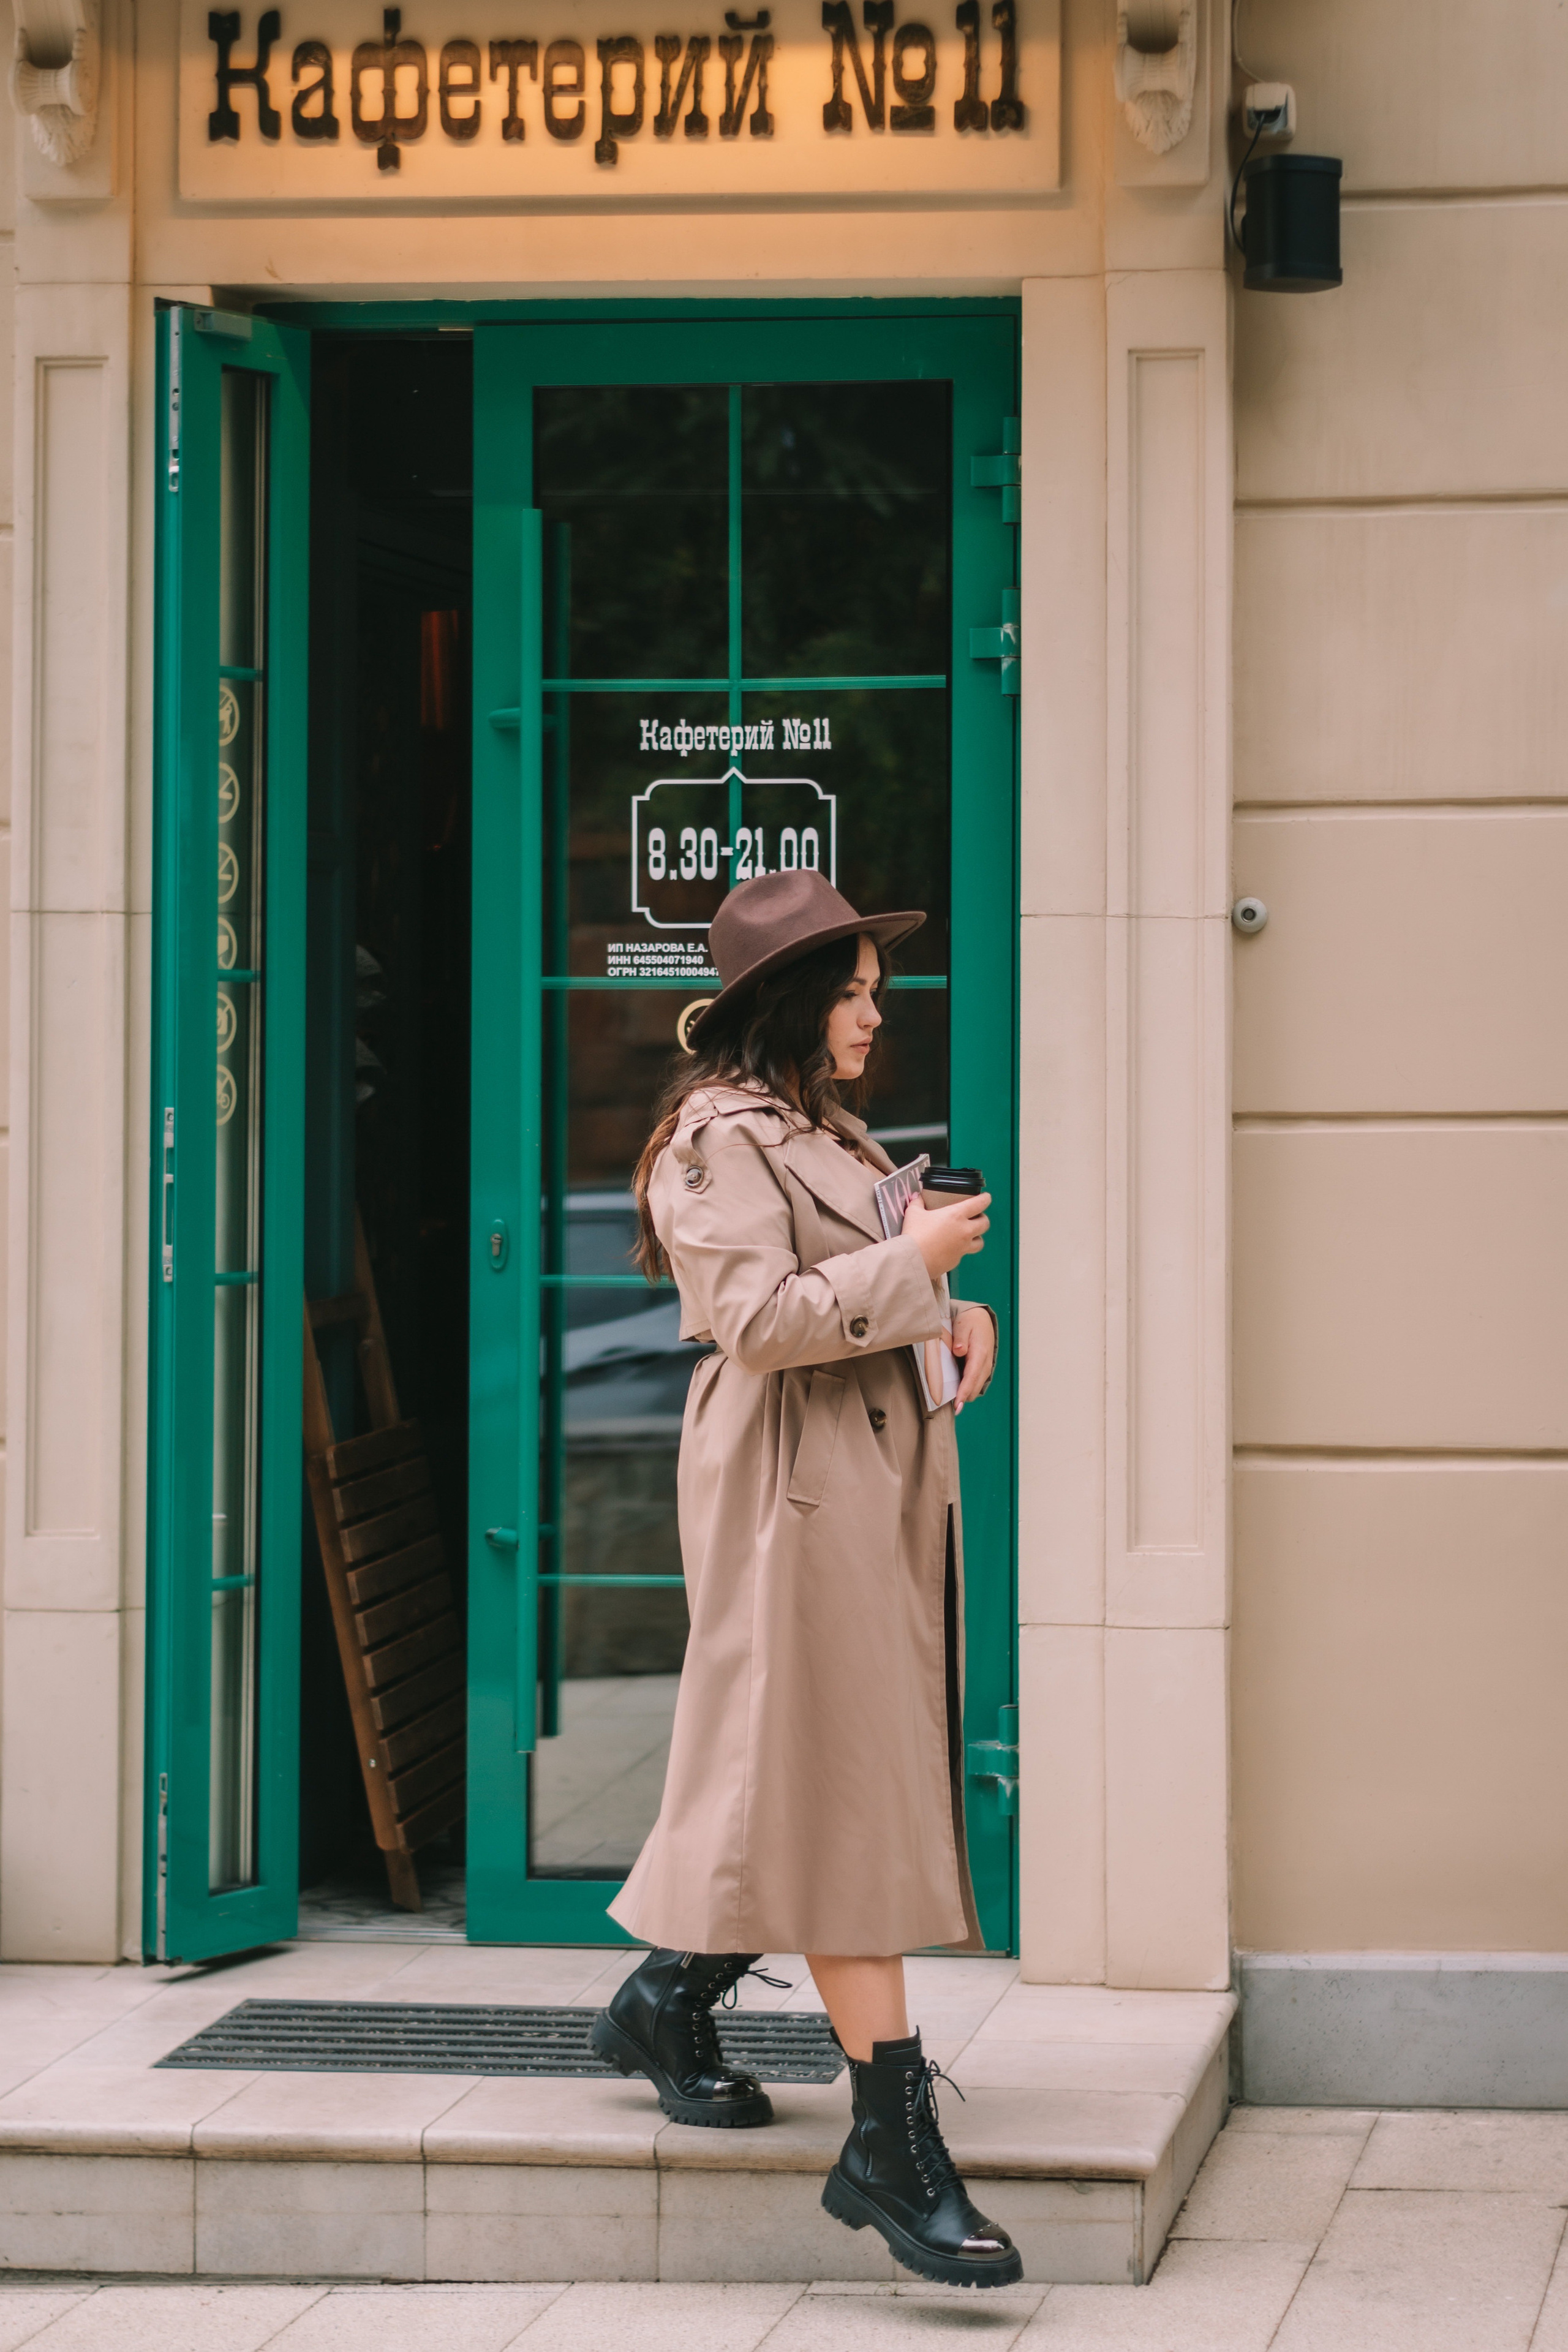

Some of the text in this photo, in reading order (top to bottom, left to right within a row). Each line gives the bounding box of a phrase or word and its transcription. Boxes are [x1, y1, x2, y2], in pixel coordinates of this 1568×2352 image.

[208, 0, 1025, 170] Кафетерий №11
[639, 718, 832, 756] Кафетерий №11
[608, 944, 708, 952] ИП НАЗАРОВА Е.А.
[608, 956, 703, 964] ИНН 645504071940
[608, 968, 636, 976] ОГРН
[881, 1160, 930, 1224] VOG
